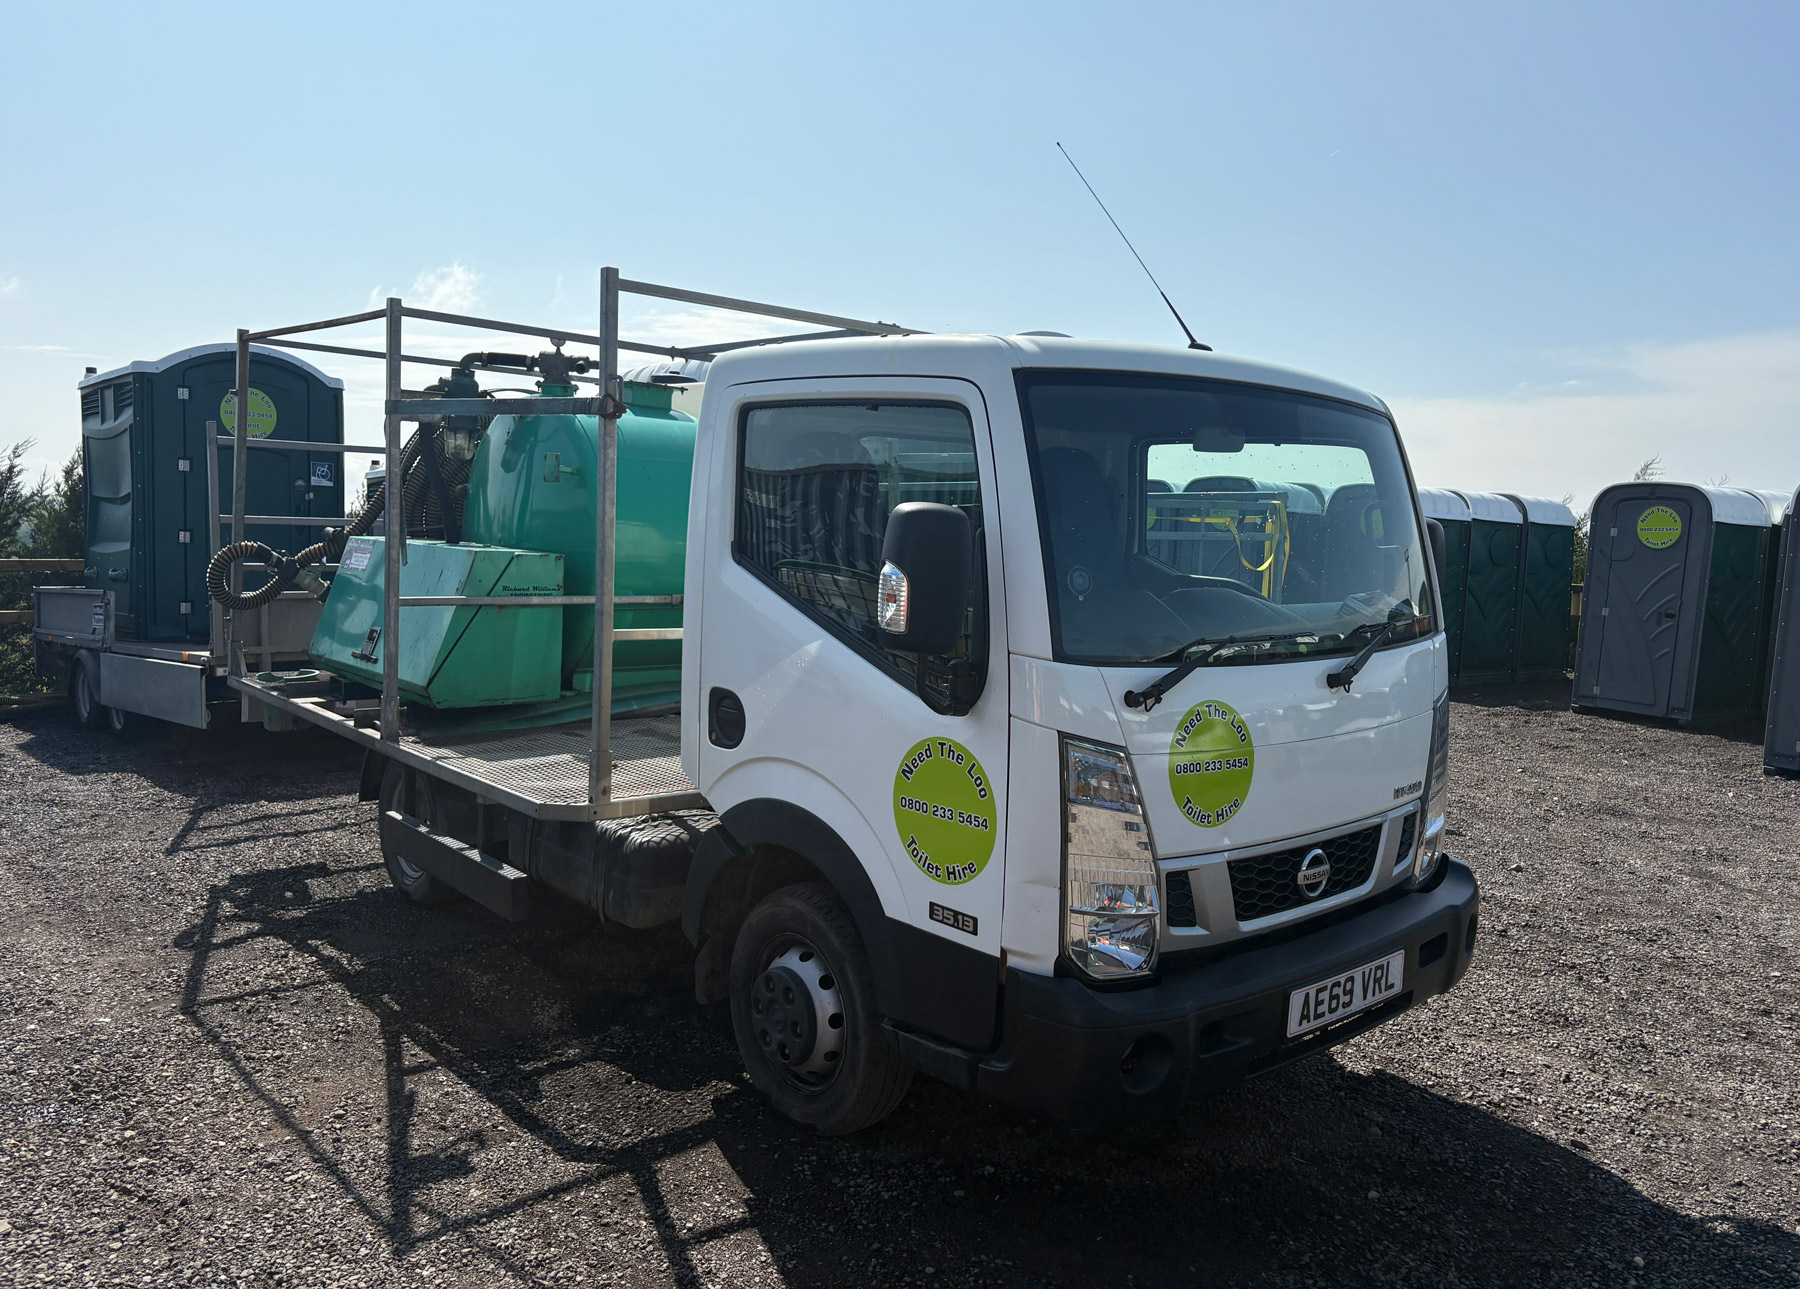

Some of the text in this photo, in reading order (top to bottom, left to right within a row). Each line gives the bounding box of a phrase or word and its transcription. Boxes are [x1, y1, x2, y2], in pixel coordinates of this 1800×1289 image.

[261, 395, 272, 409] Loo
[1641, 509, 1655, 523] Need
[1669, 512, 1677, 523] Loo
[1645, 537, 1672, 546] Toilet Hire
[1175, 703, 1248, 749] Need The Loo
[900, 741, 988, 799] Need The Loo
[1175, 757, 1249, 775] 0800 233 5454
[900, 796, 989, 831] 0800 233 5454
[1181, 796, 1241, 824] Toilet Hire
[906, 835, 977, 882] Toilet Hire
[1303, 868, 1329, 882] NISSAN
[932, 905, 974, 932] 35.13
[1298, 960, 1395, 1027] AE69 VRL
